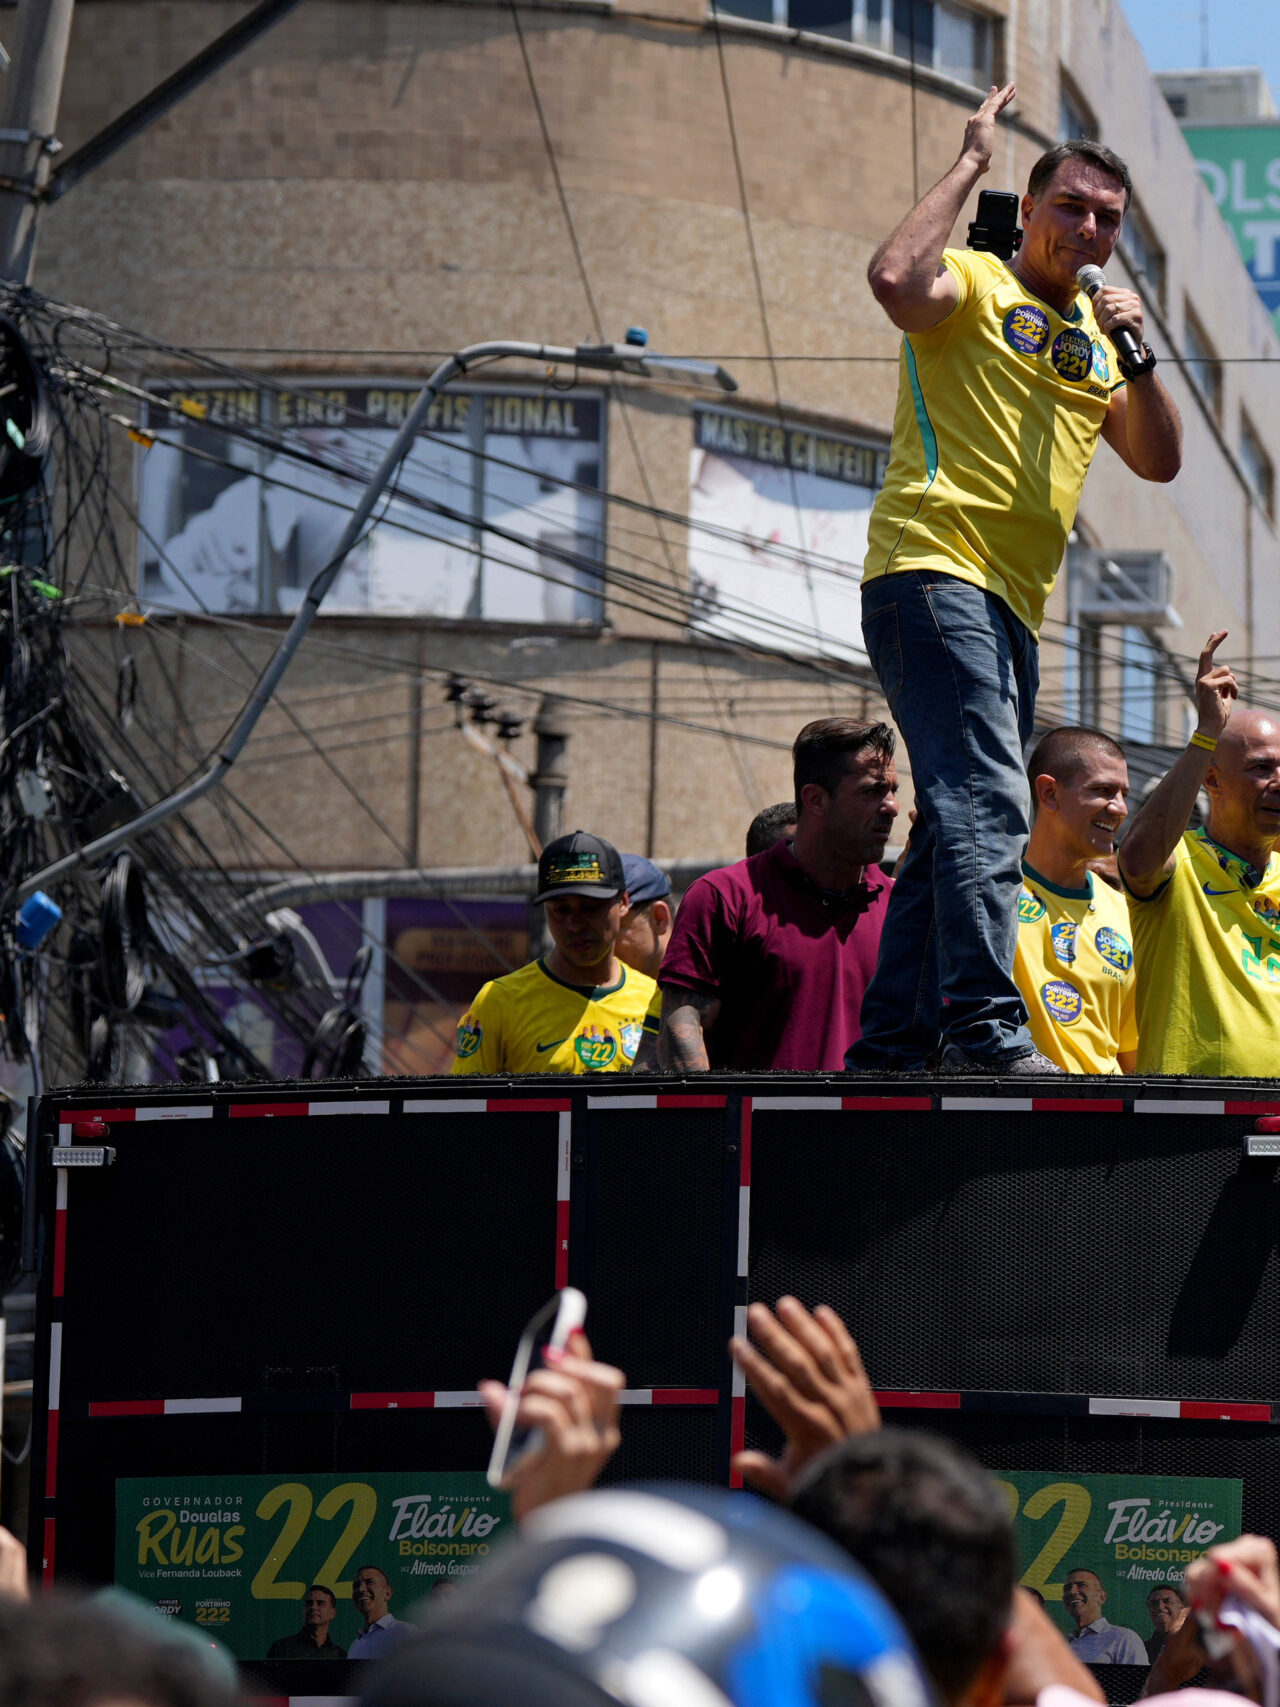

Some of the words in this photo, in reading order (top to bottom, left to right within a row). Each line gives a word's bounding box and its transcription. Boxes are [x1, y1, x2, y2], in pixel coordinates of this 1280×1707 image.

[1015, 308, 1049, 331] PORTINHO
[1010, 316, 1047, 344] 222
[1057, 342, 1092, 360] JORDY
[1057, 352, 1088, 377] 221
[1019, 899, 1041, 919] 22
[1099, 944, 1129, 967] 221
[1045, 984, 1080, 999] PORTINHO
[1046, 990, 1079, 1012] 222
[591, 1042, 612, 1061] 22
[142, 1496, 243, 1506] GOVERNADOR
[1158, 1499, 1214, 1508] Presidente
[179, 1509, 241, 1524] Douglas
[388, 1494, 501, 1542] Flávio
[1103, 1498, 1225, 1545] Flávio
[136, 1509, 246, 1566] Ruas
[250, 1482, 377, 1600] 22
[990, 1480, 1091, 1601] 2
[399, 1539, 490, 1556] Bolsonaro
[138, 1570, 155, 1578] Vice
[156, 1568, 200, 1578] Fernanda
[202, 1568, 242, 1578] Louback
[410, 1560, 446, 1575] Alfredo
[1126, 1564, 1165, 1580] Alfredo
[195, 1600, 231, 1608] PORTINHO
[195, 1607, 231, 1622] 222
